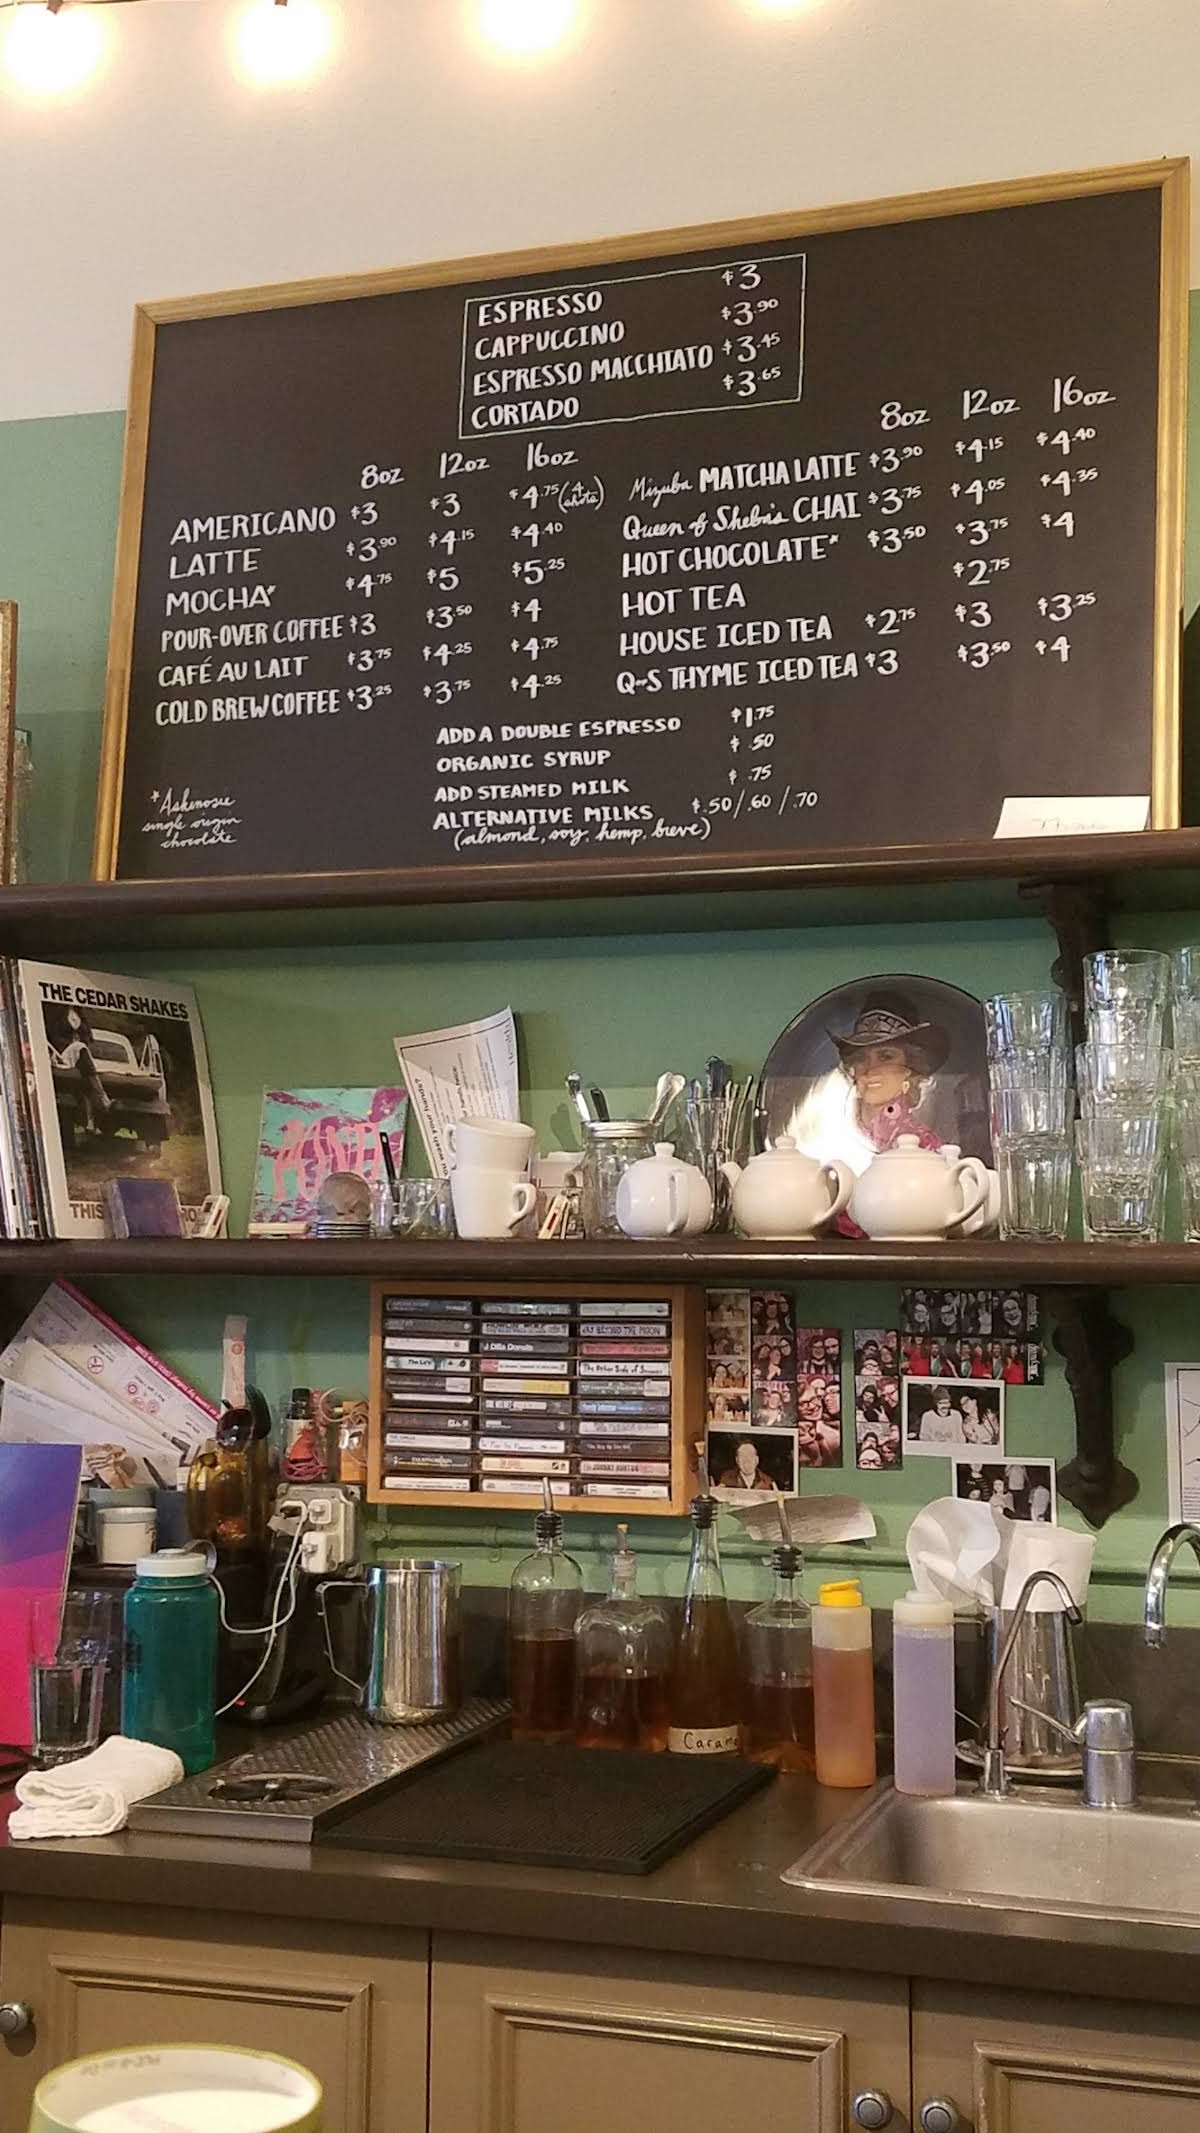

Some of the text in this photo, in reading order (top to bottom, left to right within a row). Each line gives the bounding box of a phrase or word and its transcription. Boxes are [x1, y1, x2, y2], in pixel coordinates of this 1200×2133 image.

[478, 263, 762, 327] ESPRESSO $3
[474, 298, 779, 361] CAPPUCCINO $3.90
[473, 332, 781, 397] ESPRESSO MACCHIATO $3.45
[471, 366, 782, 429] CORTADO $3.65
[880, 375, 1117, 431] 8oz 12oz 16oz
[360, 441, 579, 490] 8oz 12oz 16oz
[628, 427, 1096, 509] Mizuba MATCHA LATTE $3.90 $4.15 $4.40
[169, 506, 336, 546] AMERICANO
[350, 501, 378, 526] $3
[429, 492, 461, 517] $3
[622, 467, 1099, 541] Queen of Sheba's CHAI $3.75 $4.05 $4.35
[169, 521, 564, 580] LATTE $3.90 $4.15 $4.40
[622, 549, 675, 579] HOT
[866, 525, 927, 554] $3.50
[954, 517, 1009, 546] $3.75
[1040, 511, 1075, 538] $4
[426, 566, 459, 591] $5
[511, 557, 566, 585] $5.25
[621, 557, 1011, 618] HOT TEA $2.75
[161, 598, 543, 653] POUR-OVER COFFEE $3 $3.50 $4
[619, 626, 708, 657] HOUSE
[716, 620, 781, 648] ICED
[785, 614, 833, 643] TEA
[954, 601, 992, 628] $3
[1037, 592, 1097, 622] $3.25
[158, 655, 213, 687] CAFÉ
[216, 661, 248, 683] AU
[254, 655, 309, 680] LAIT
[510, 636, 559, 661] $4.75
[616, 635, 1071, 695] Q-S THYME ICED TEA $3 $3.50 $4
[155, 699, 208, 726] COLD
[211, 694, 270, 722] BREW
[271, 688, 340, 717] COFFEE
[510, 674, 562, 699] $4.25
[435, 727, 476, 745] ADD
[477, 725, 494, 743] A
[500, 722, 574, 742] DOUBLE
[578, 717, 681, 738] ESPRESSO
[436, 753, 534, 773] ORGANIC
[543, 749, 612, 768] SYRUP
[432, 806, 573, 832] ALTERNATIVE
[583, 804, 654, 823] MILKS
[433, 785, 474, 803] ADD
[476, 783, 562, 801] STEAMED
[571, 778, 631, 796] MILK
[160, 829, 237, 849] chocolate
[37, 981, 188, 1019] THE CEDAR SHAKES
[70, 1203, 104, 1219] THIS
